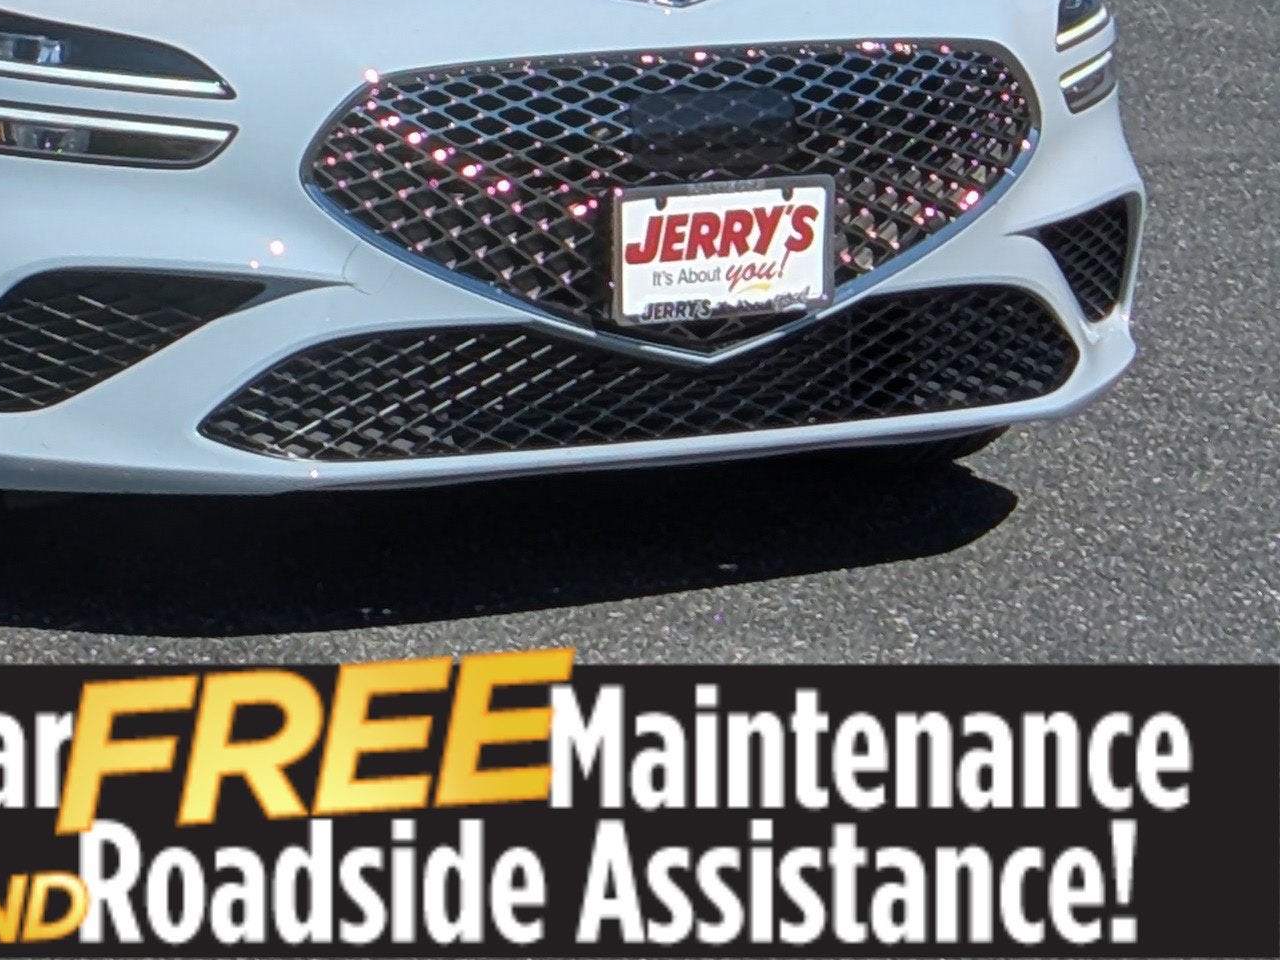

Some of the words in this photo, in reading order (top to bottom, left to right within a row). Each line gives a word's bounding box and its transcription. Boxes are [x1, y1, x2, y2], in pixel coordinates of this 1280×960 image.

[625, 205, 818, 265] JERRY'S
[652, 270, 674, 287] It's
[677, 266, 721, 284] About
[725, 248, 790, 292] you!
